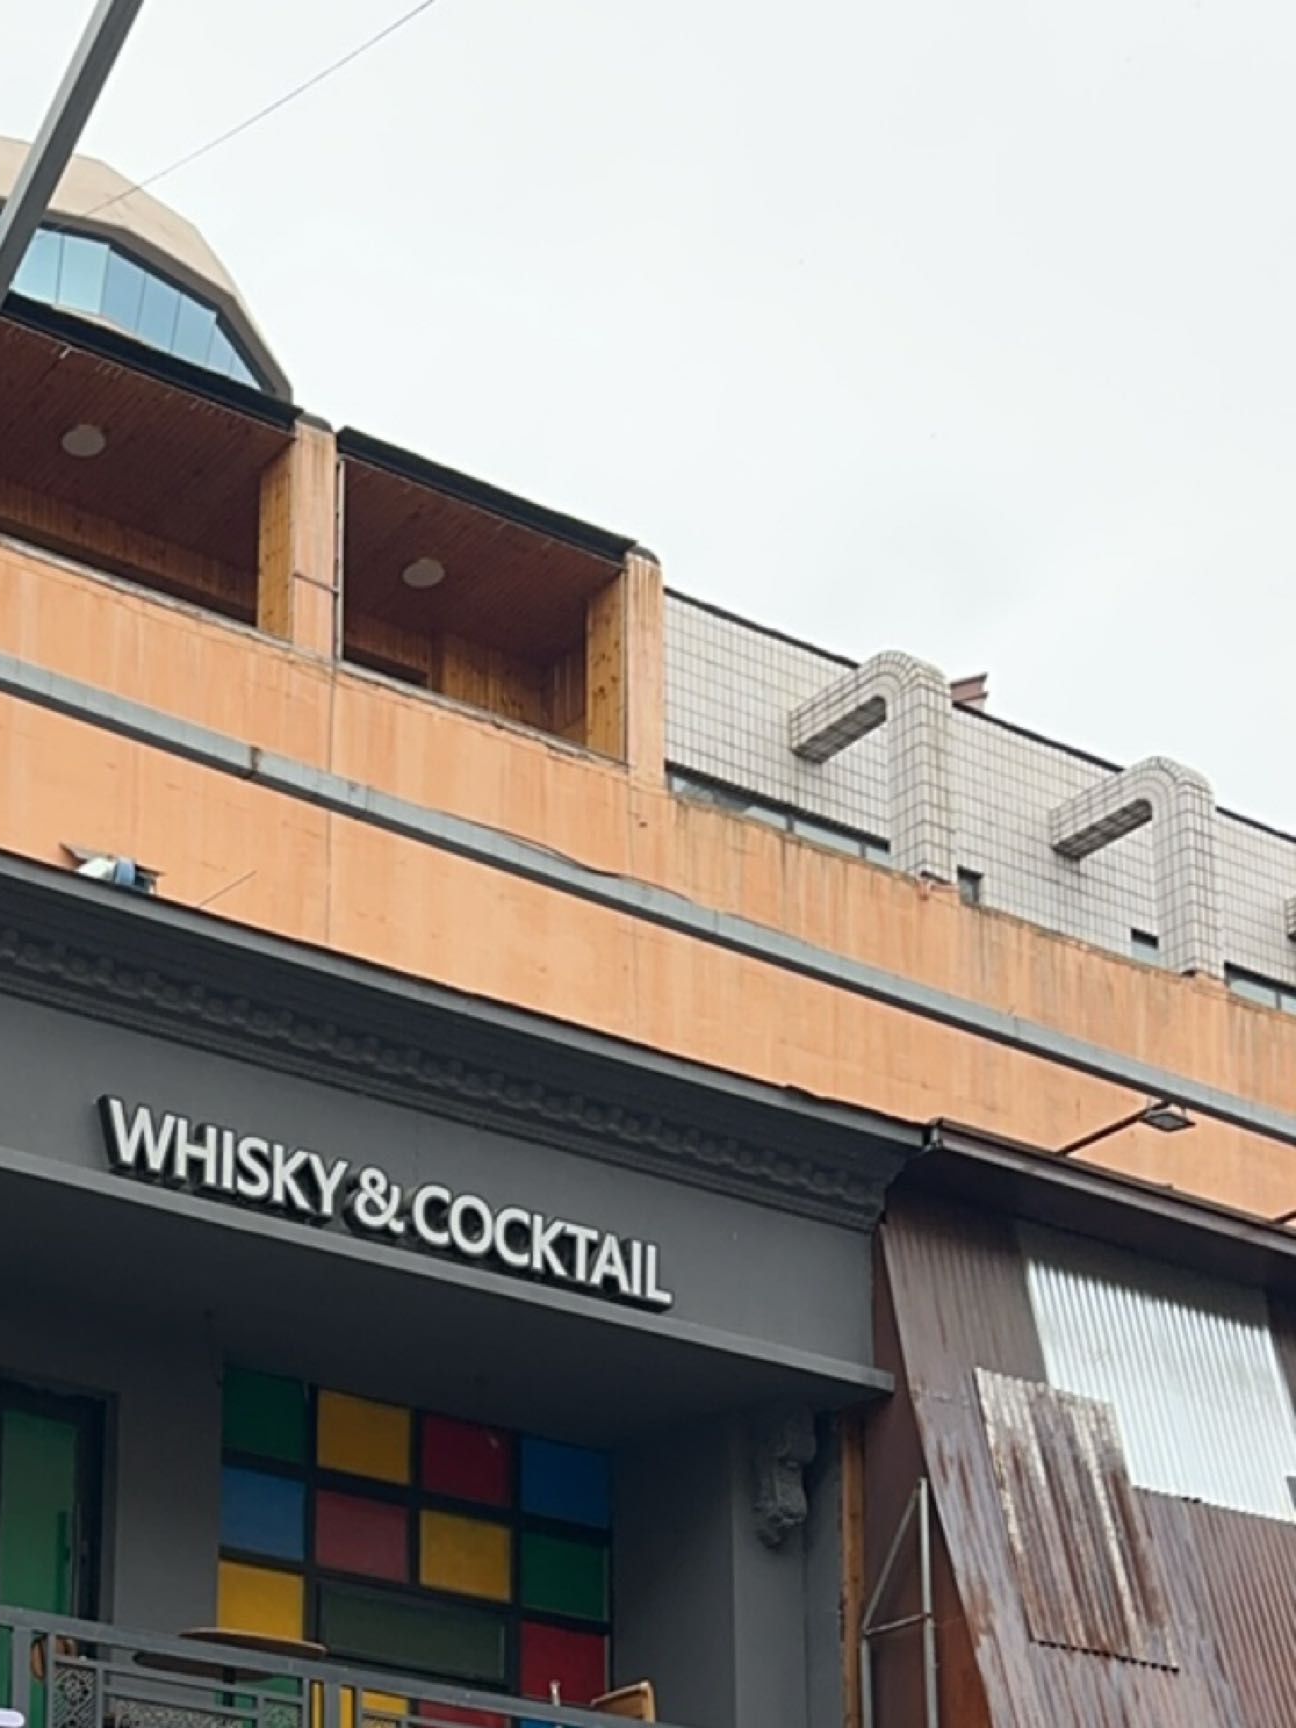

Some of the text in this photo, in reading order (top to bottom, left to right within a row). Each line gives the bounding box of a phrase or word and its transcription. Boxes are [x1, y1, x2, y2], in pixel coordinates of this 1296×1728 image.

[100, 1096, 673, 1308] WHISKY & COCKTAIL
